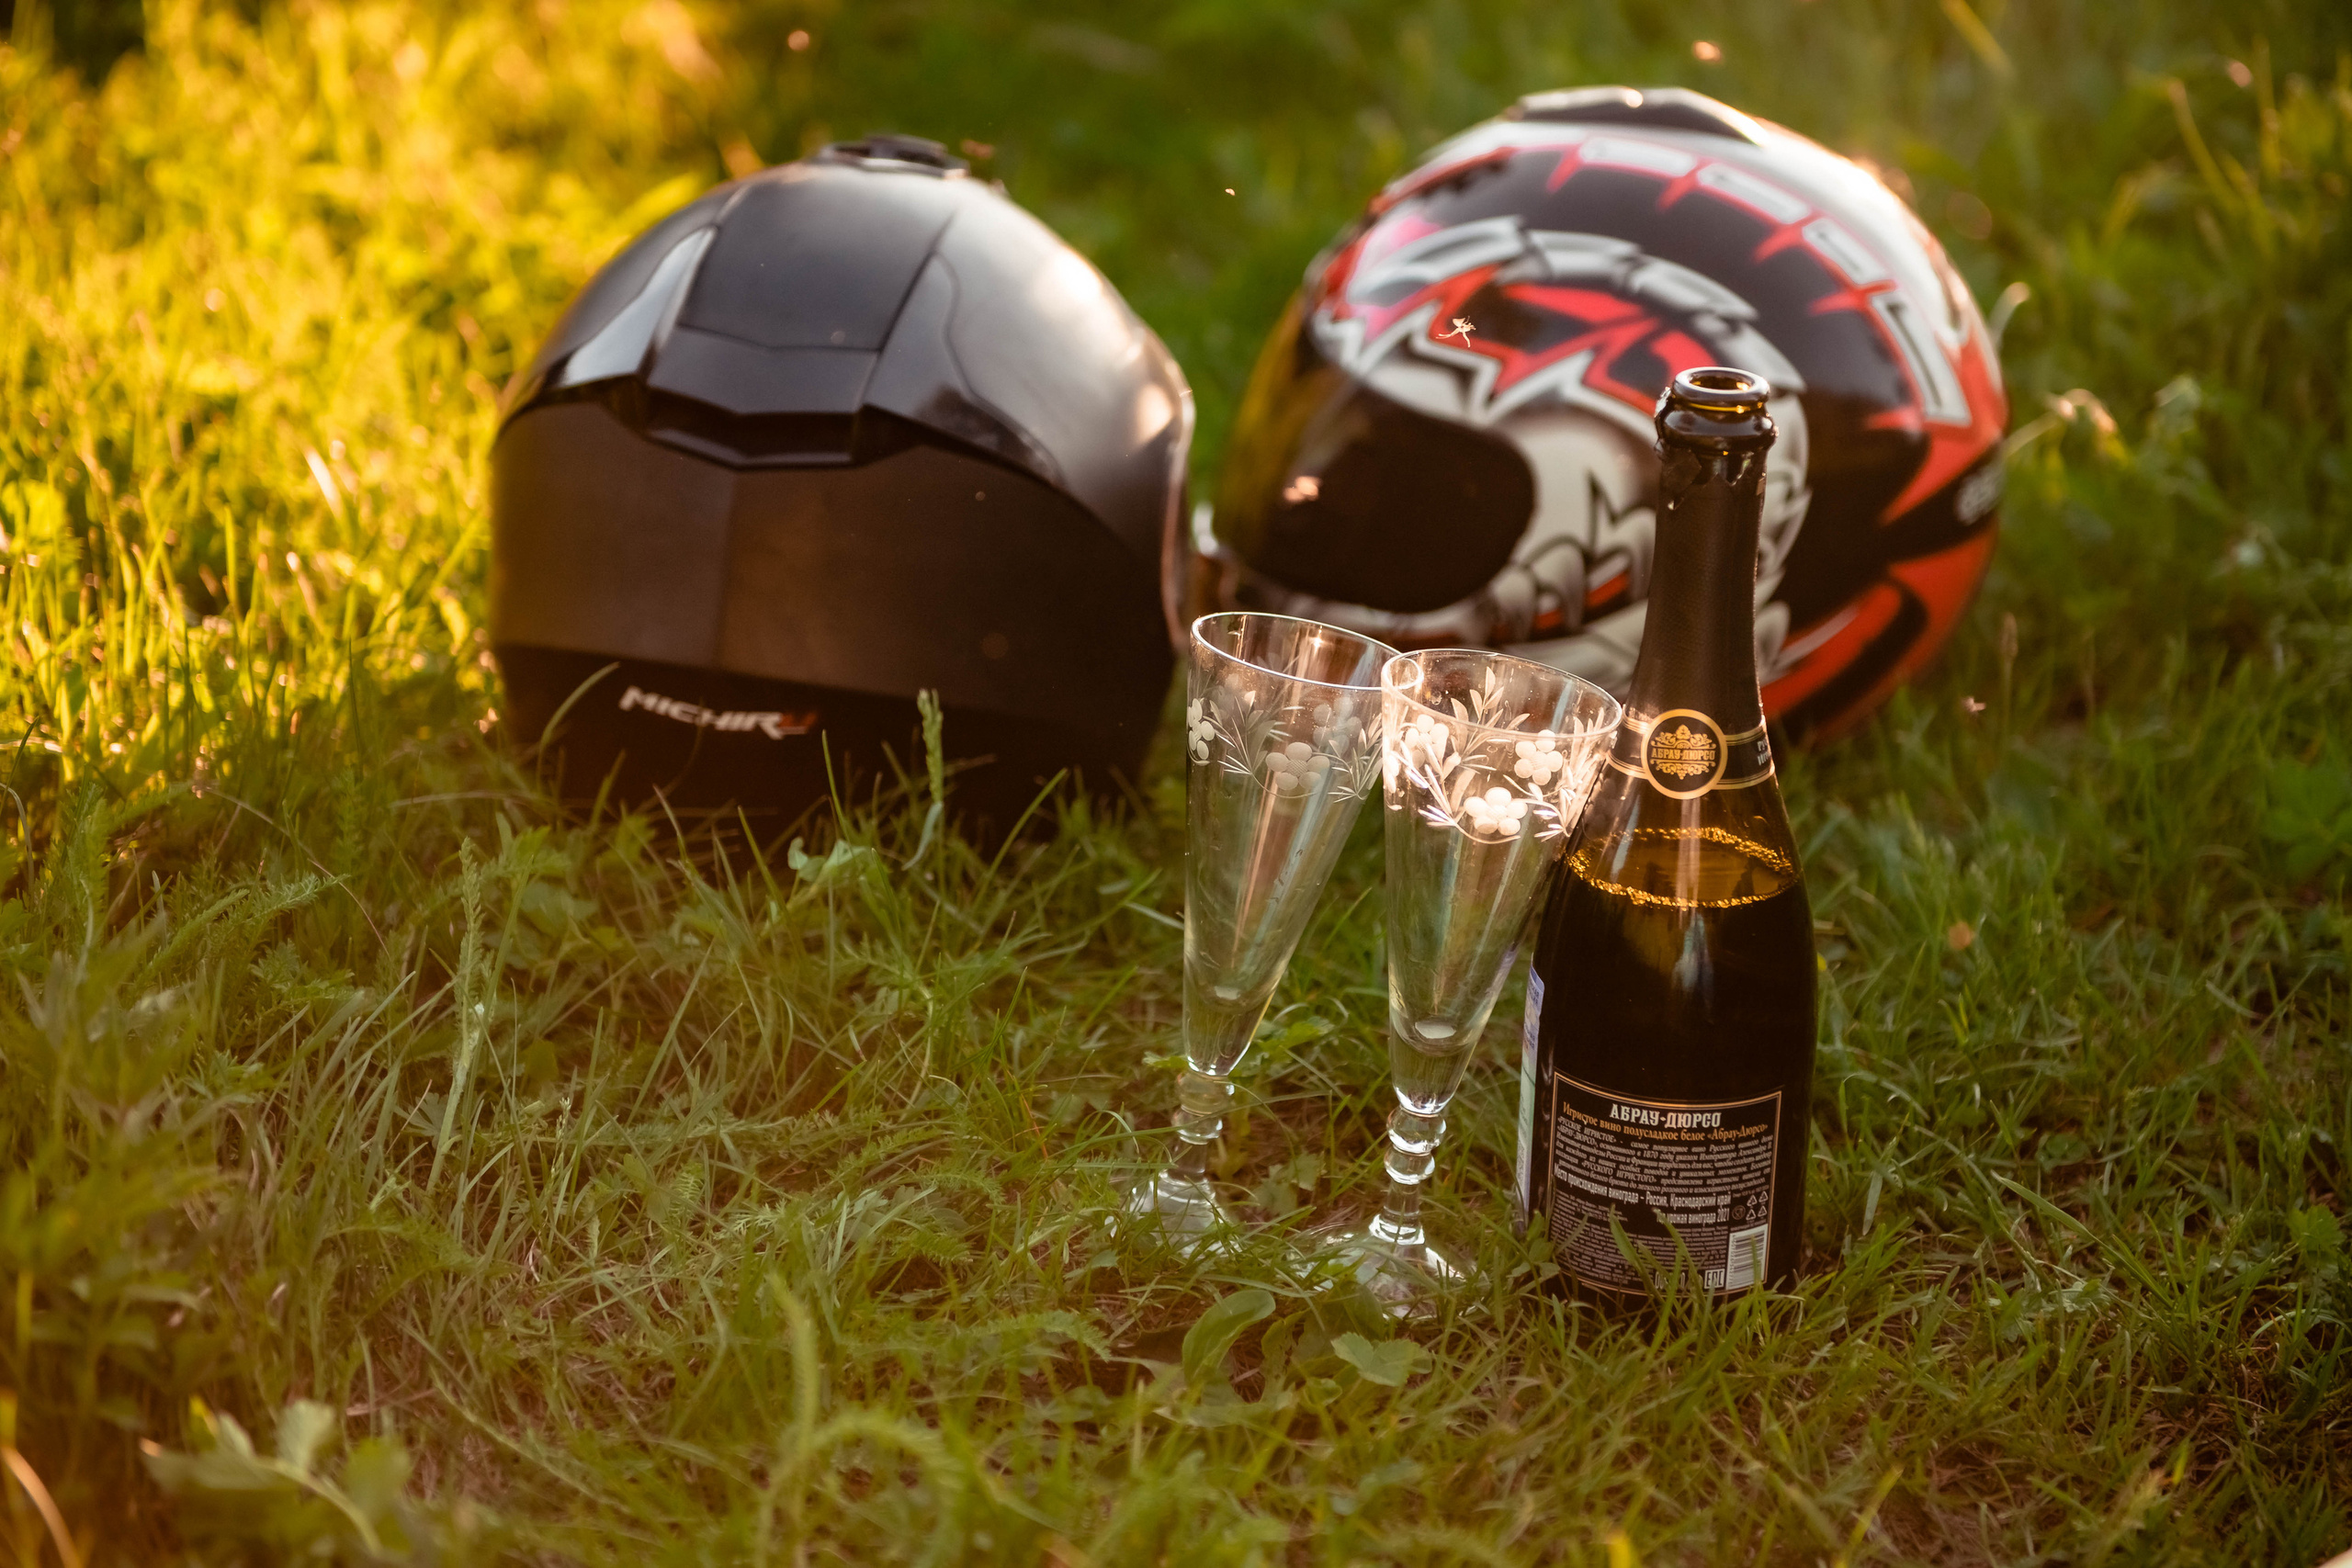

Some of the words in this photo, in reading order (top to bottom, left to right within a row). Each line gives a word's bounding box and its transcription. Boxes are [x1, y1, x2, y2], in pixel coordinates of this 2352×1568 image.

[1651, 748, 1715, 761] АБРАУ-ДЮРСО
[1564, 1101, 1599, 1125] Игристое
[1600, 1120, 1622, 1133] вино
[1623, 1126, 1679, 1141] полусладкое
[1680, 1129, 1706, 1141] белое
[1707, 1123, 1769, 1142] «Абрау-Дюрсо»
[1610, 1103, 1722, 1129] АБРАУ-ДЮРСО
[1643, 1149, 1658, 1159] 1870
[1554, 1162, 1567, 1182] Место
[1567, 1173, 1608, 1198] происхождения
[1608, 1186, 1639, 1205] винограда
[1645, 1190, 1668, 1207] Россия,
[1670, 1192, 1716, 1211] Краснодарский
[1717, 1191, 1732, 1209] край
[1688, 1212, 1716, 1227] винограда
[1717, 1208, 1731, 1223] 2021
